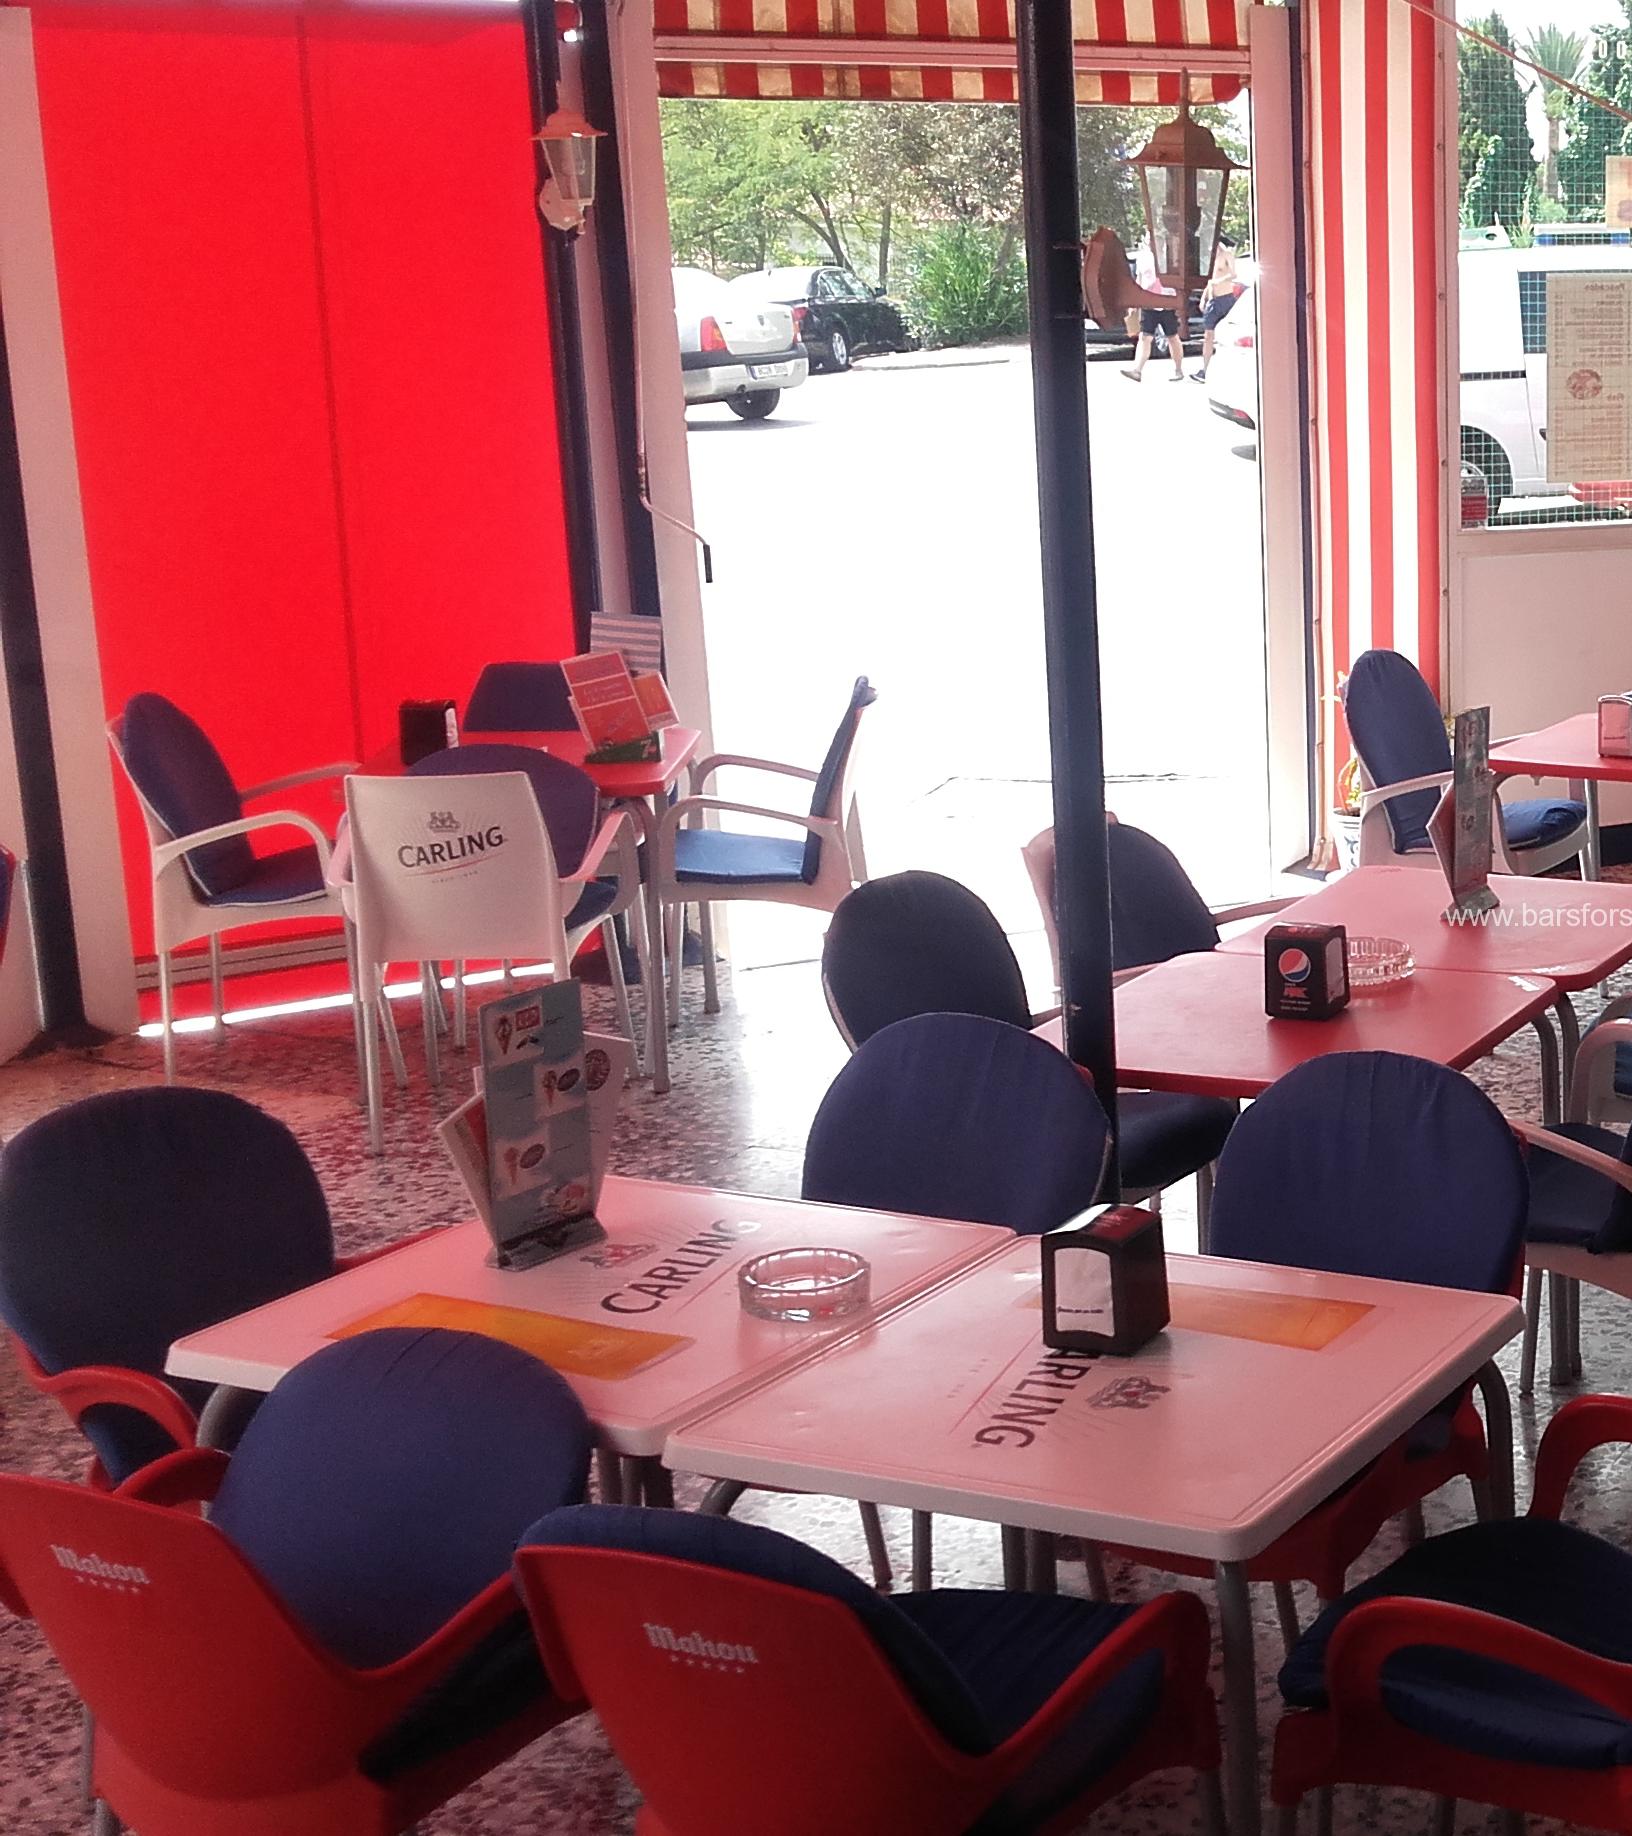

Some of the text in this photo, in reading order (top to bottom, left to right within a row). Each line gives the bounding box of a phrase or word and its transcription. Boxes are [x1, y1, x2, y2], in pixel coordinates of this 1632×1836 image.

[398, 826, 503, 868] CARLING
[601, 1218, 763, 1314] CARLING
[49, 1543, 150, 1585] Mahou
[643, 1622, 759, 1663] Mahou
